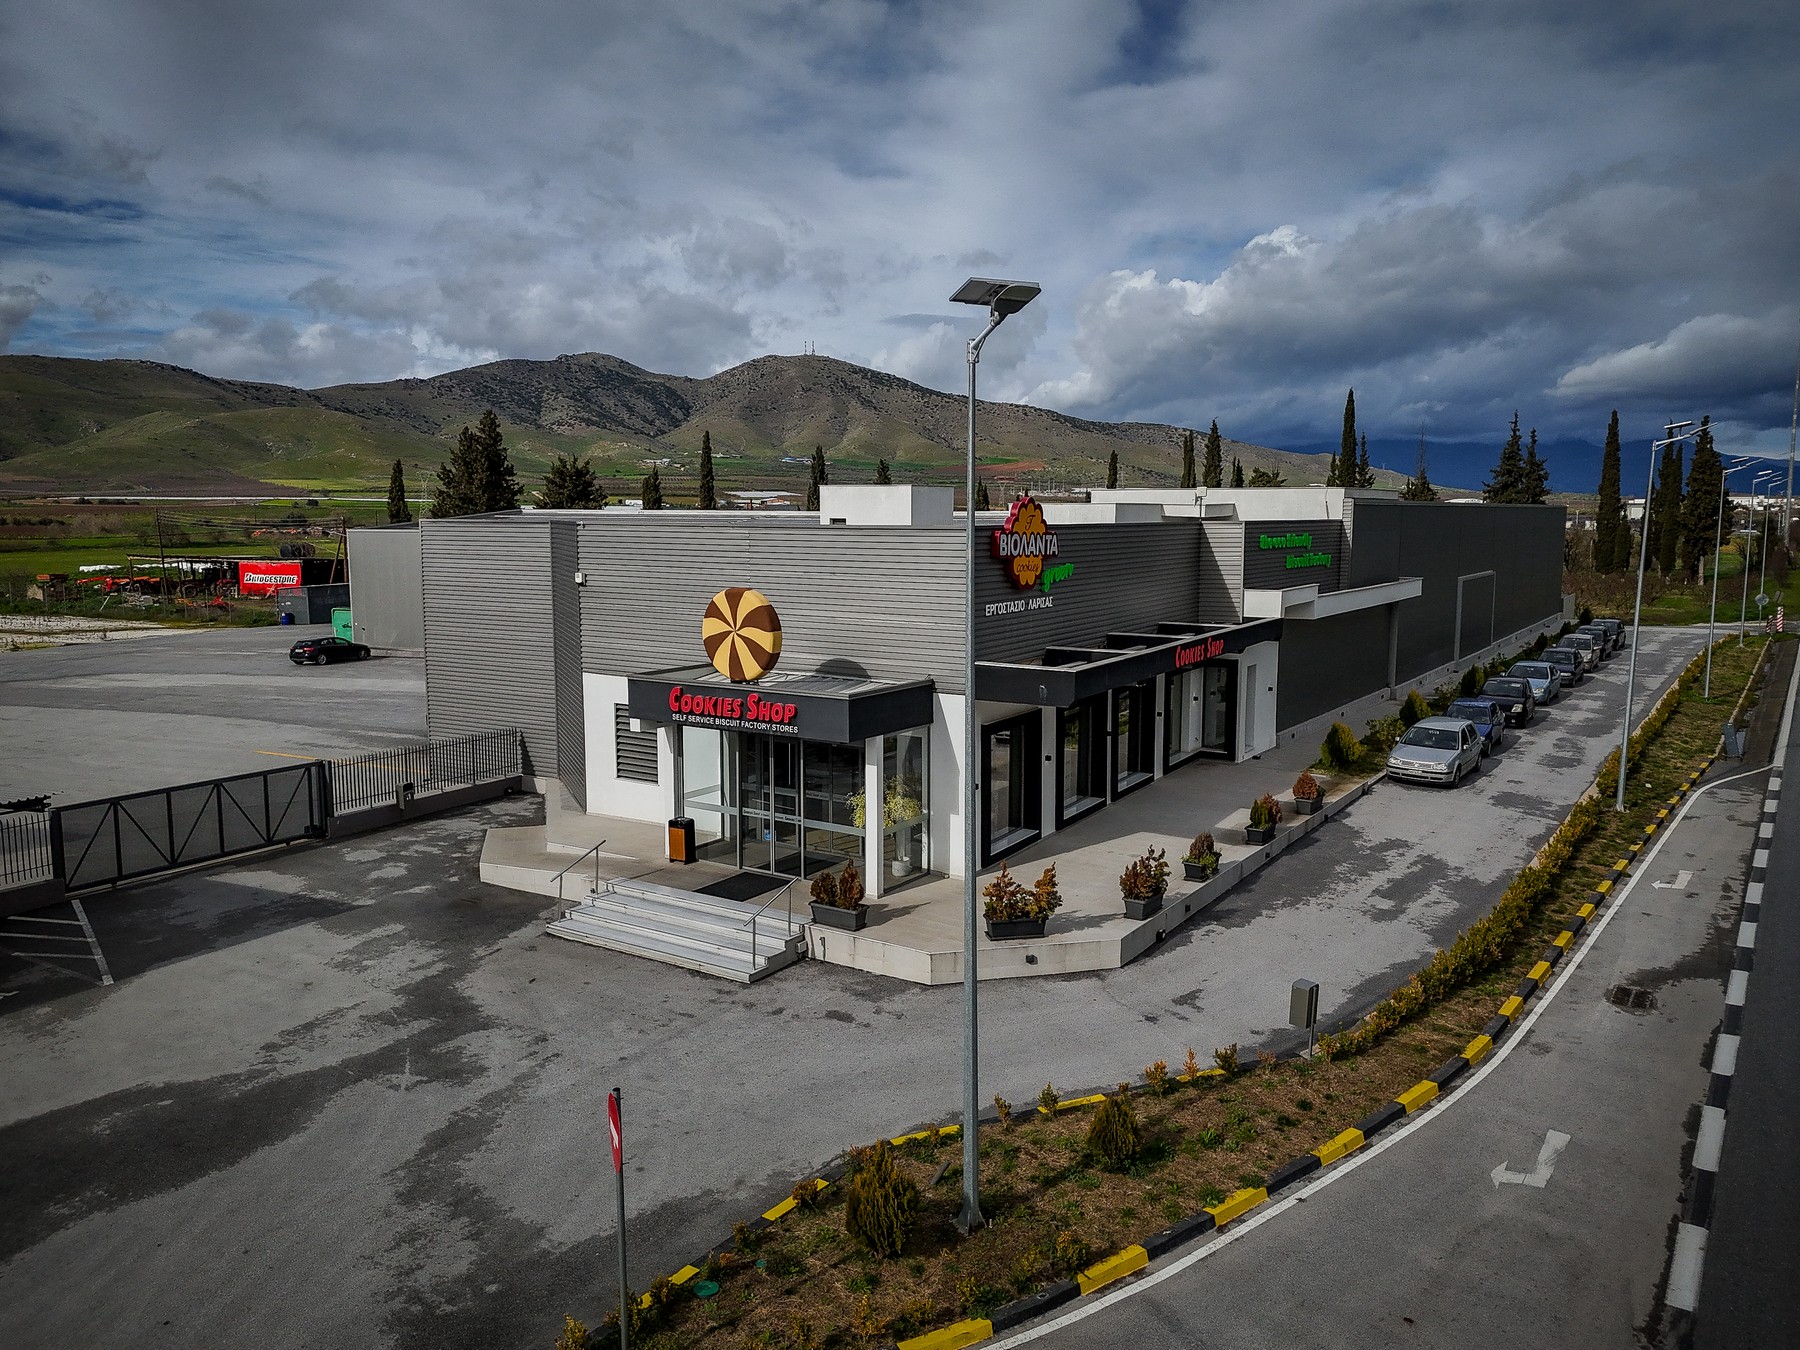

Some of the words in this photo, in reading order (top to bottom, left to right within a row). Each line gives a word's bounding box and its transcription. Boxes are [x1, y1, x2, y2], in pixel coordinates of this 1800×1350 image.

[1000, 533, 1059, 557] ΒΙΟΛΑΝΤΑ
[244, 572, 298, 585] BRIDGESTONE
[1041, 563, 1075, 593] green
[985, 600, 1026, 616] ΕΡΓΟΣΤΑΣΙΟ
[1028, 596, 1054, 610] ΛΑΡΙΣΑΣ
[668, 686, 743, 719] COOKIES
[746, 693, 797, 724] SHOP
[671, 713, 687, 721] SELF
[687, 714, 715, 725] SERVICE
[715, 718, 740, 727] BISCUIT
[741, 720, 772, 731] FACTORY
[771, 724, 799, 733] STORES
